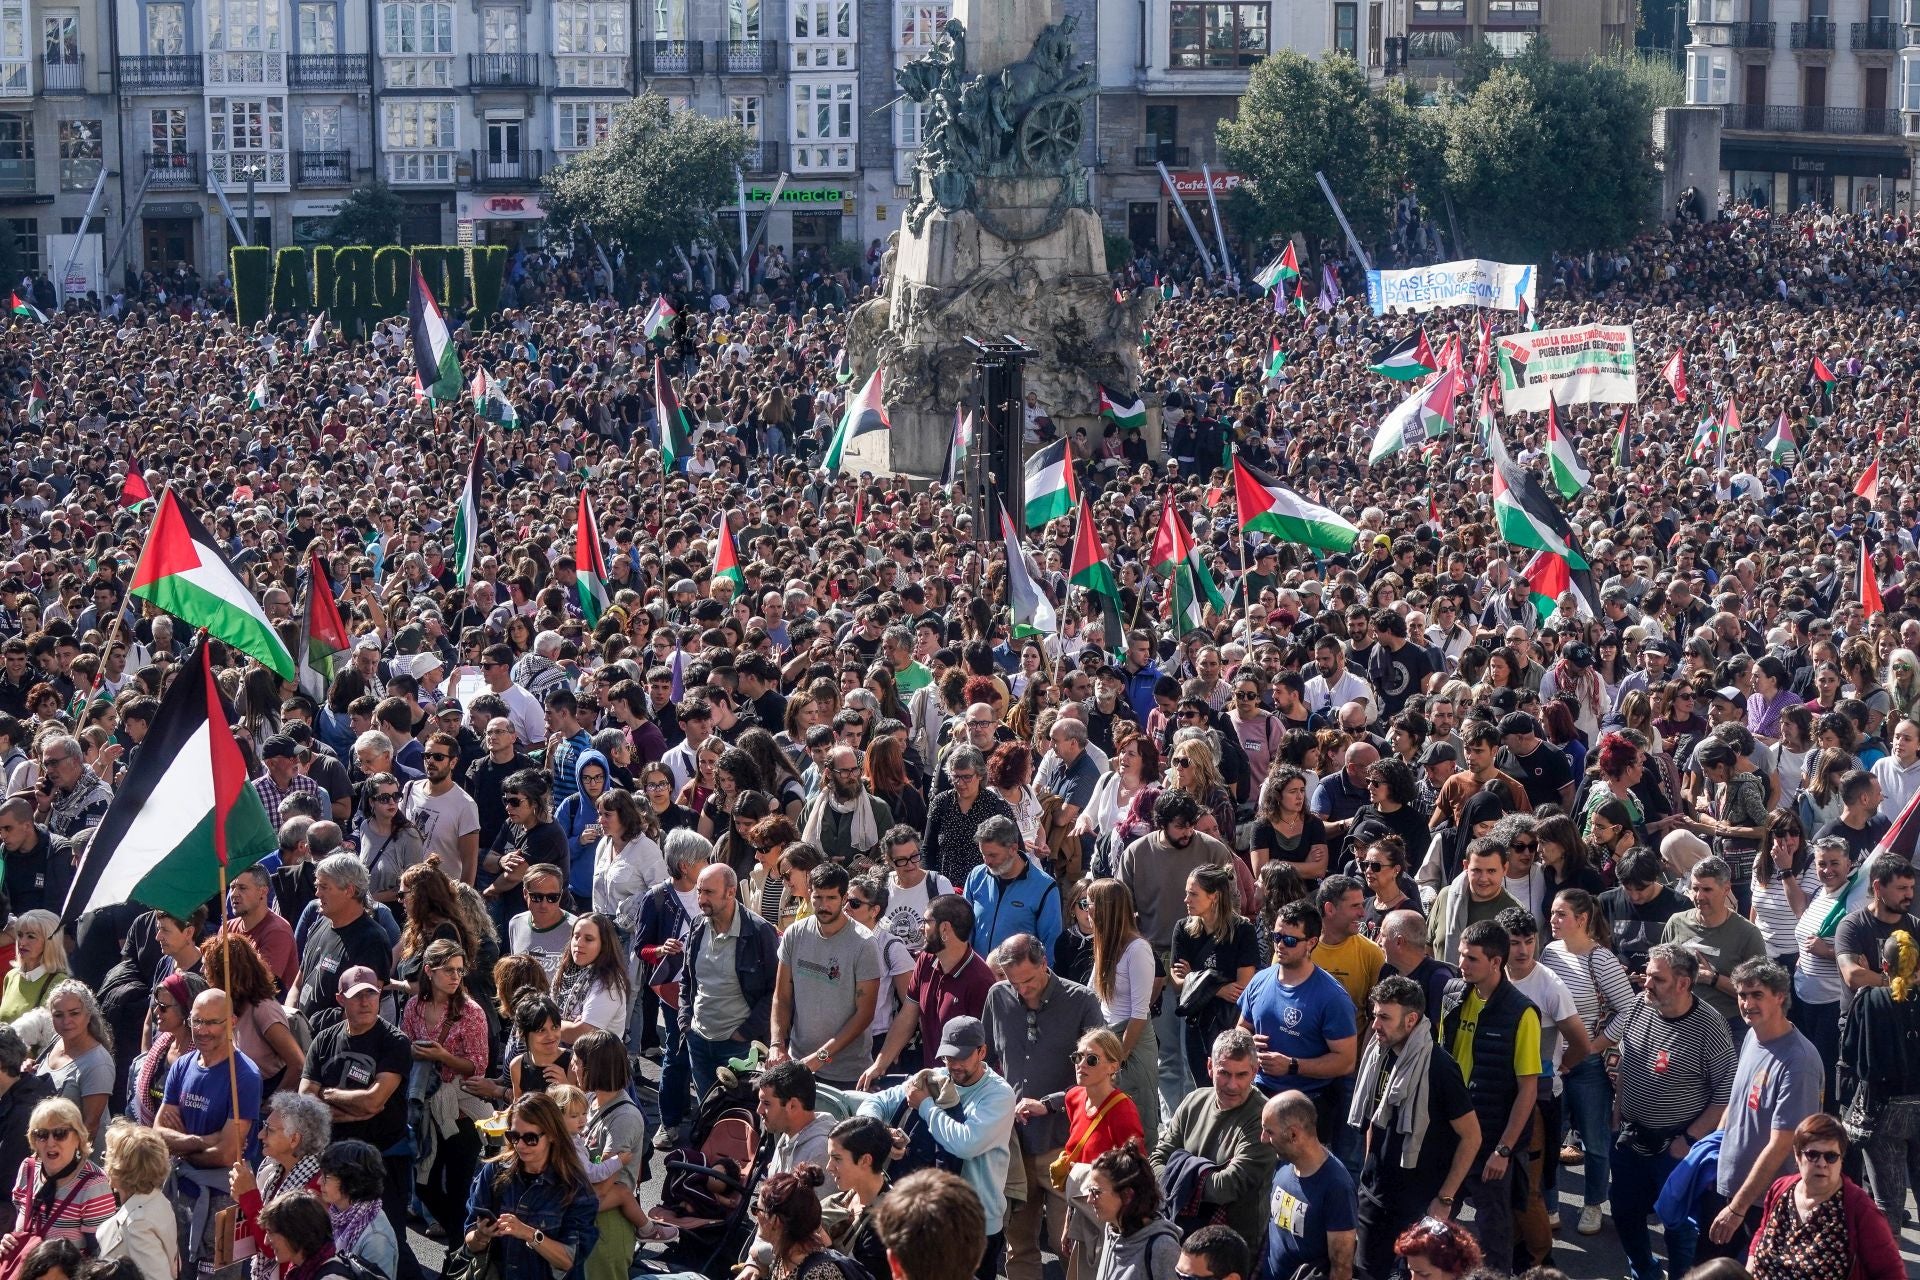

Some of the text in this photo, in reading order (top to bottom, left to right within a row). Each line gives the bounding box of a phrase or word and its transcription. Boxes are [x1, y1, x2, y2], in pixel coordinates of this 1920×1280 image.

[751, 187, 839, 202] Famacia
[491, 198, 525, 211] PINK
[1384, 271, 1457, 291] IKASLEOK
[1532, 336, 1550, 348] SOLO
[1550, 335, 1559, 346] LA
[1561, 333, 1582, 345] CLASE
[1539, 347, 1560, 358] PUEDE
[349, 1069, 369, 1082] LIBRE!
